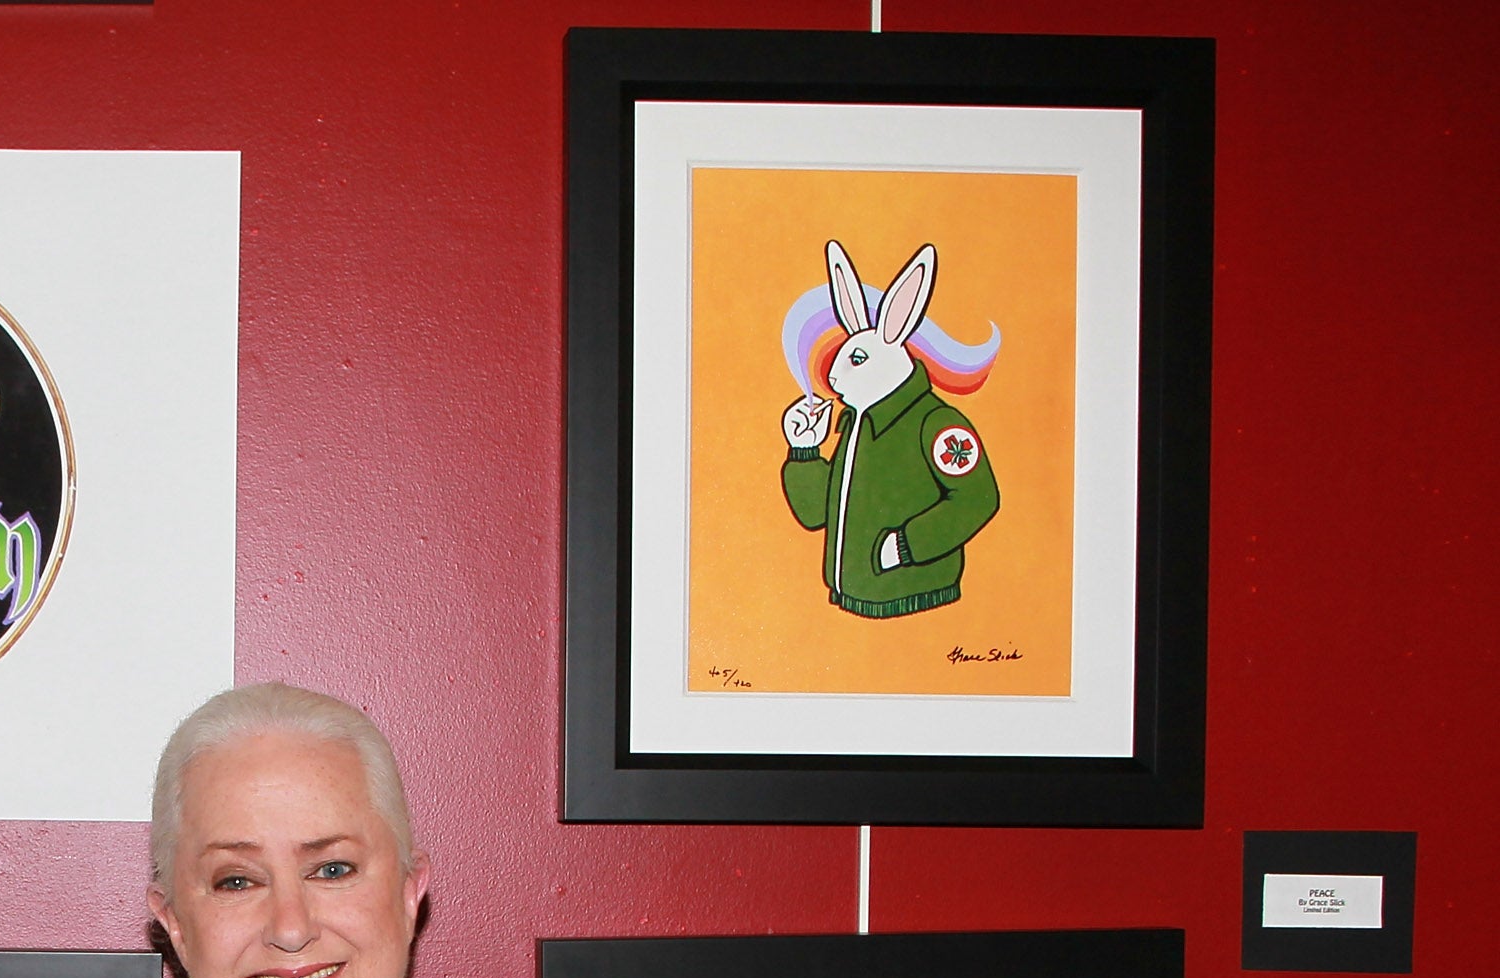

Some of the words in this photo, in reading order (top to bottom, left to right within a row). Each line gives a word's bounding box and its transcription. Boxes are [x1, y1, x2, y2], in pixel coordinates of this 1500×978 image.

[1309, 889, 1335, 898] PEACE
[1299, 898, 1308, 907] By
[1310, 898, 1328, 906] Grace
[1330, 898, 1346, 906] Slick
